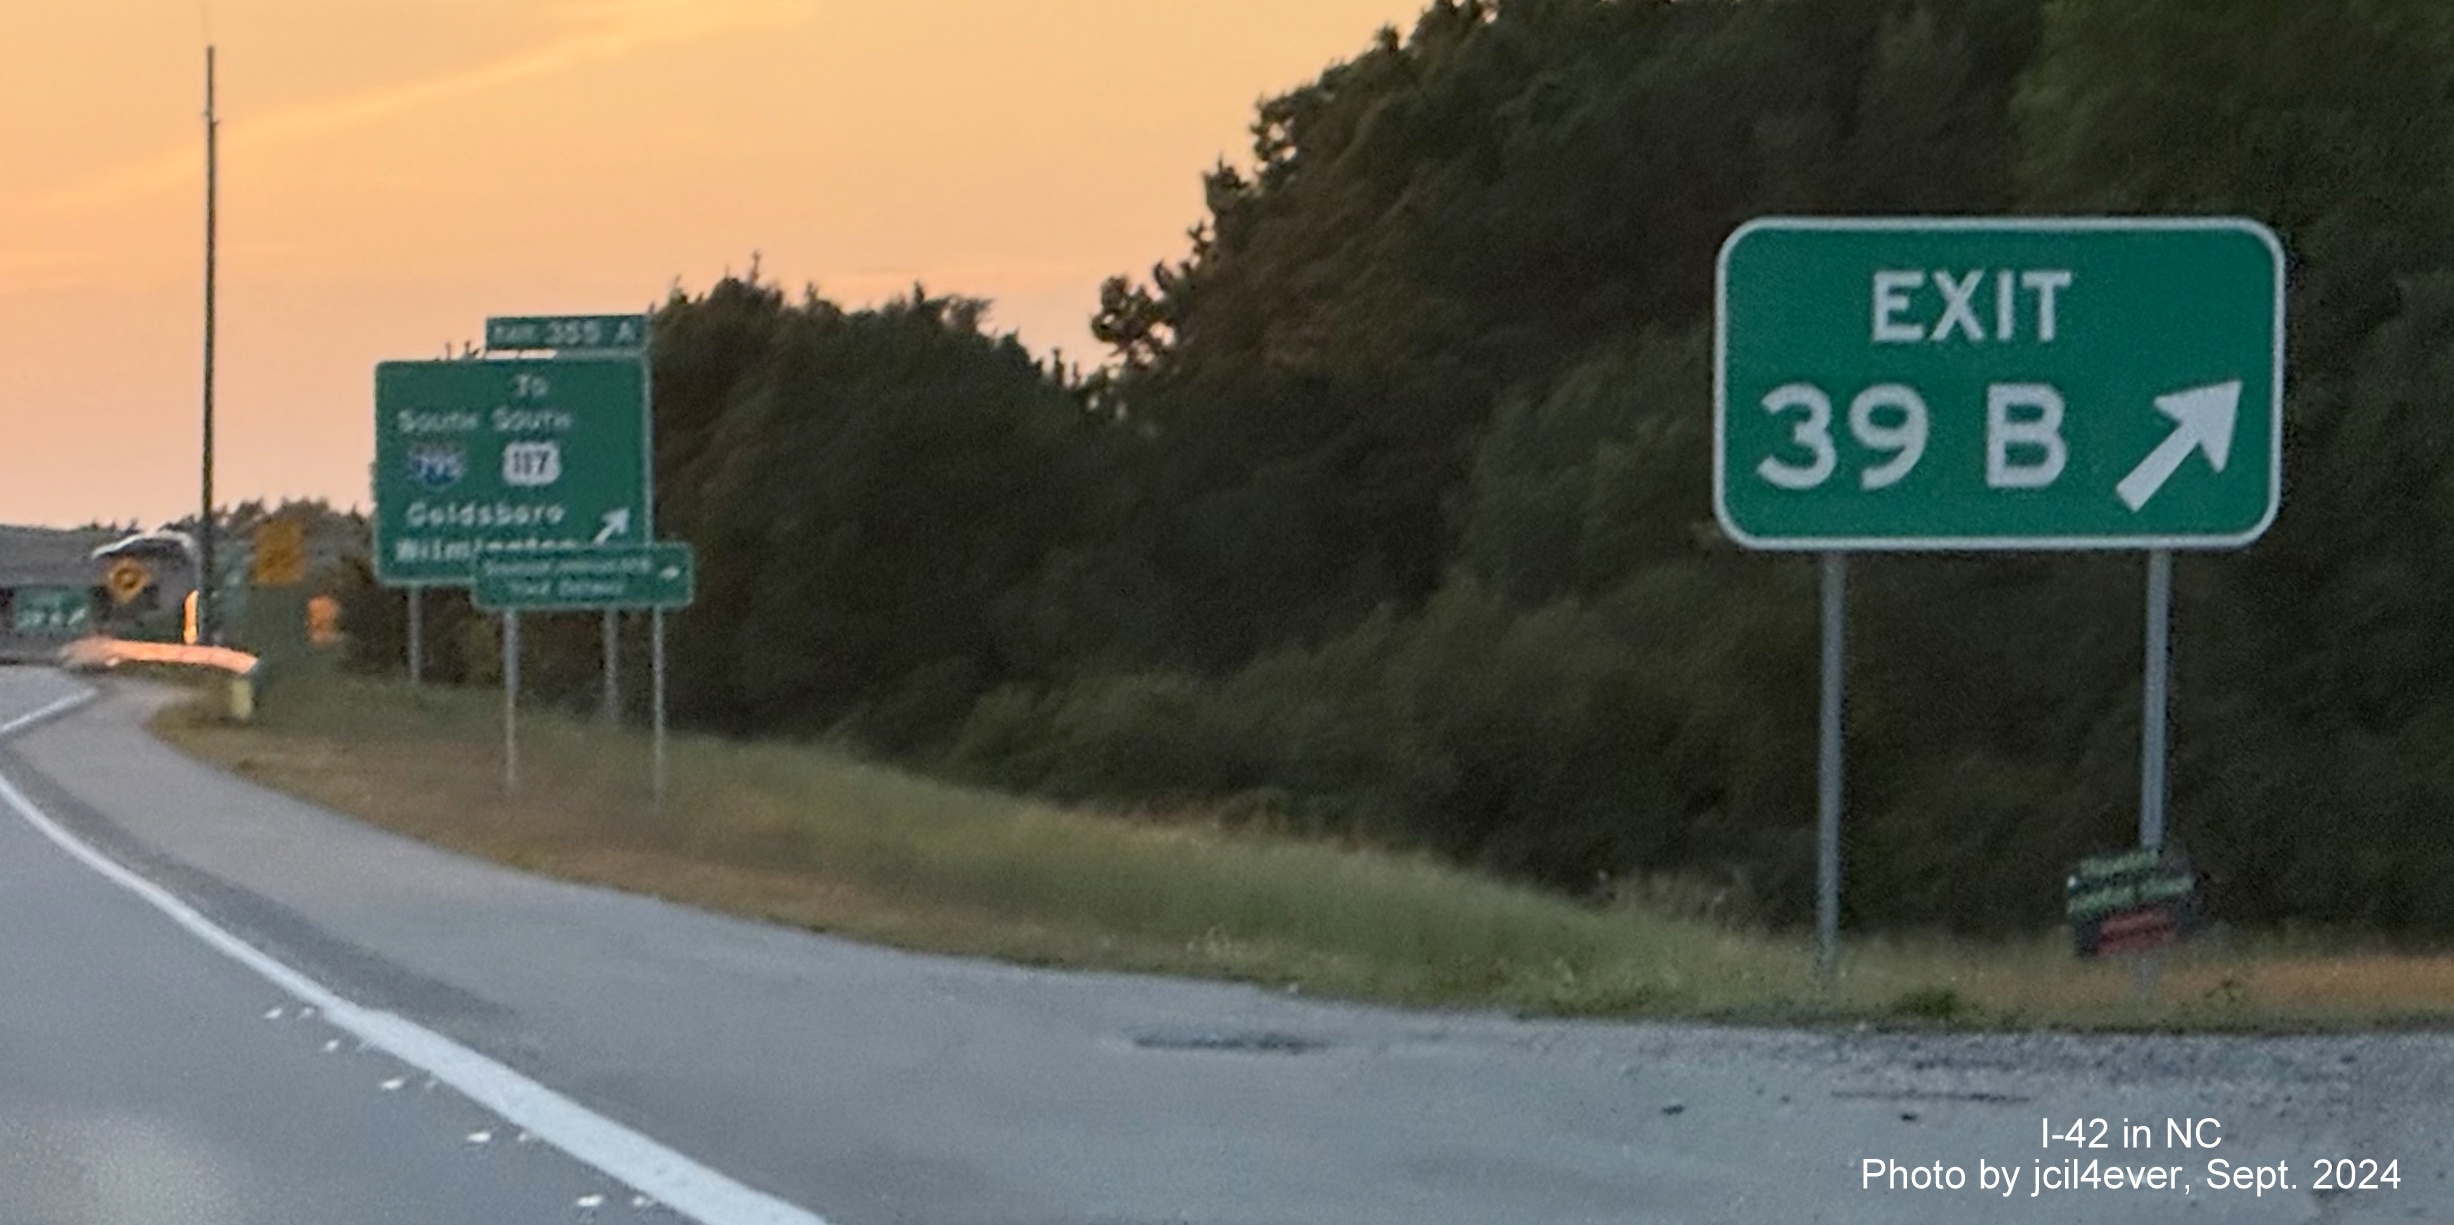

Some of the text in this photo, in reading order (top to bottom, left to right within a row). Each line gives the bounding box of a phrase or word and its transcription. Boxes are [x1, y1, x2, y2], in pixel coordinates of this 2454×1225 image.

[1873, 271, 2072, 342] EXIT
[613, 320, 638, 342] A
[1757, 383, 2068, 489] 39 B
[405, 502, 566, 527] Goldsboro
